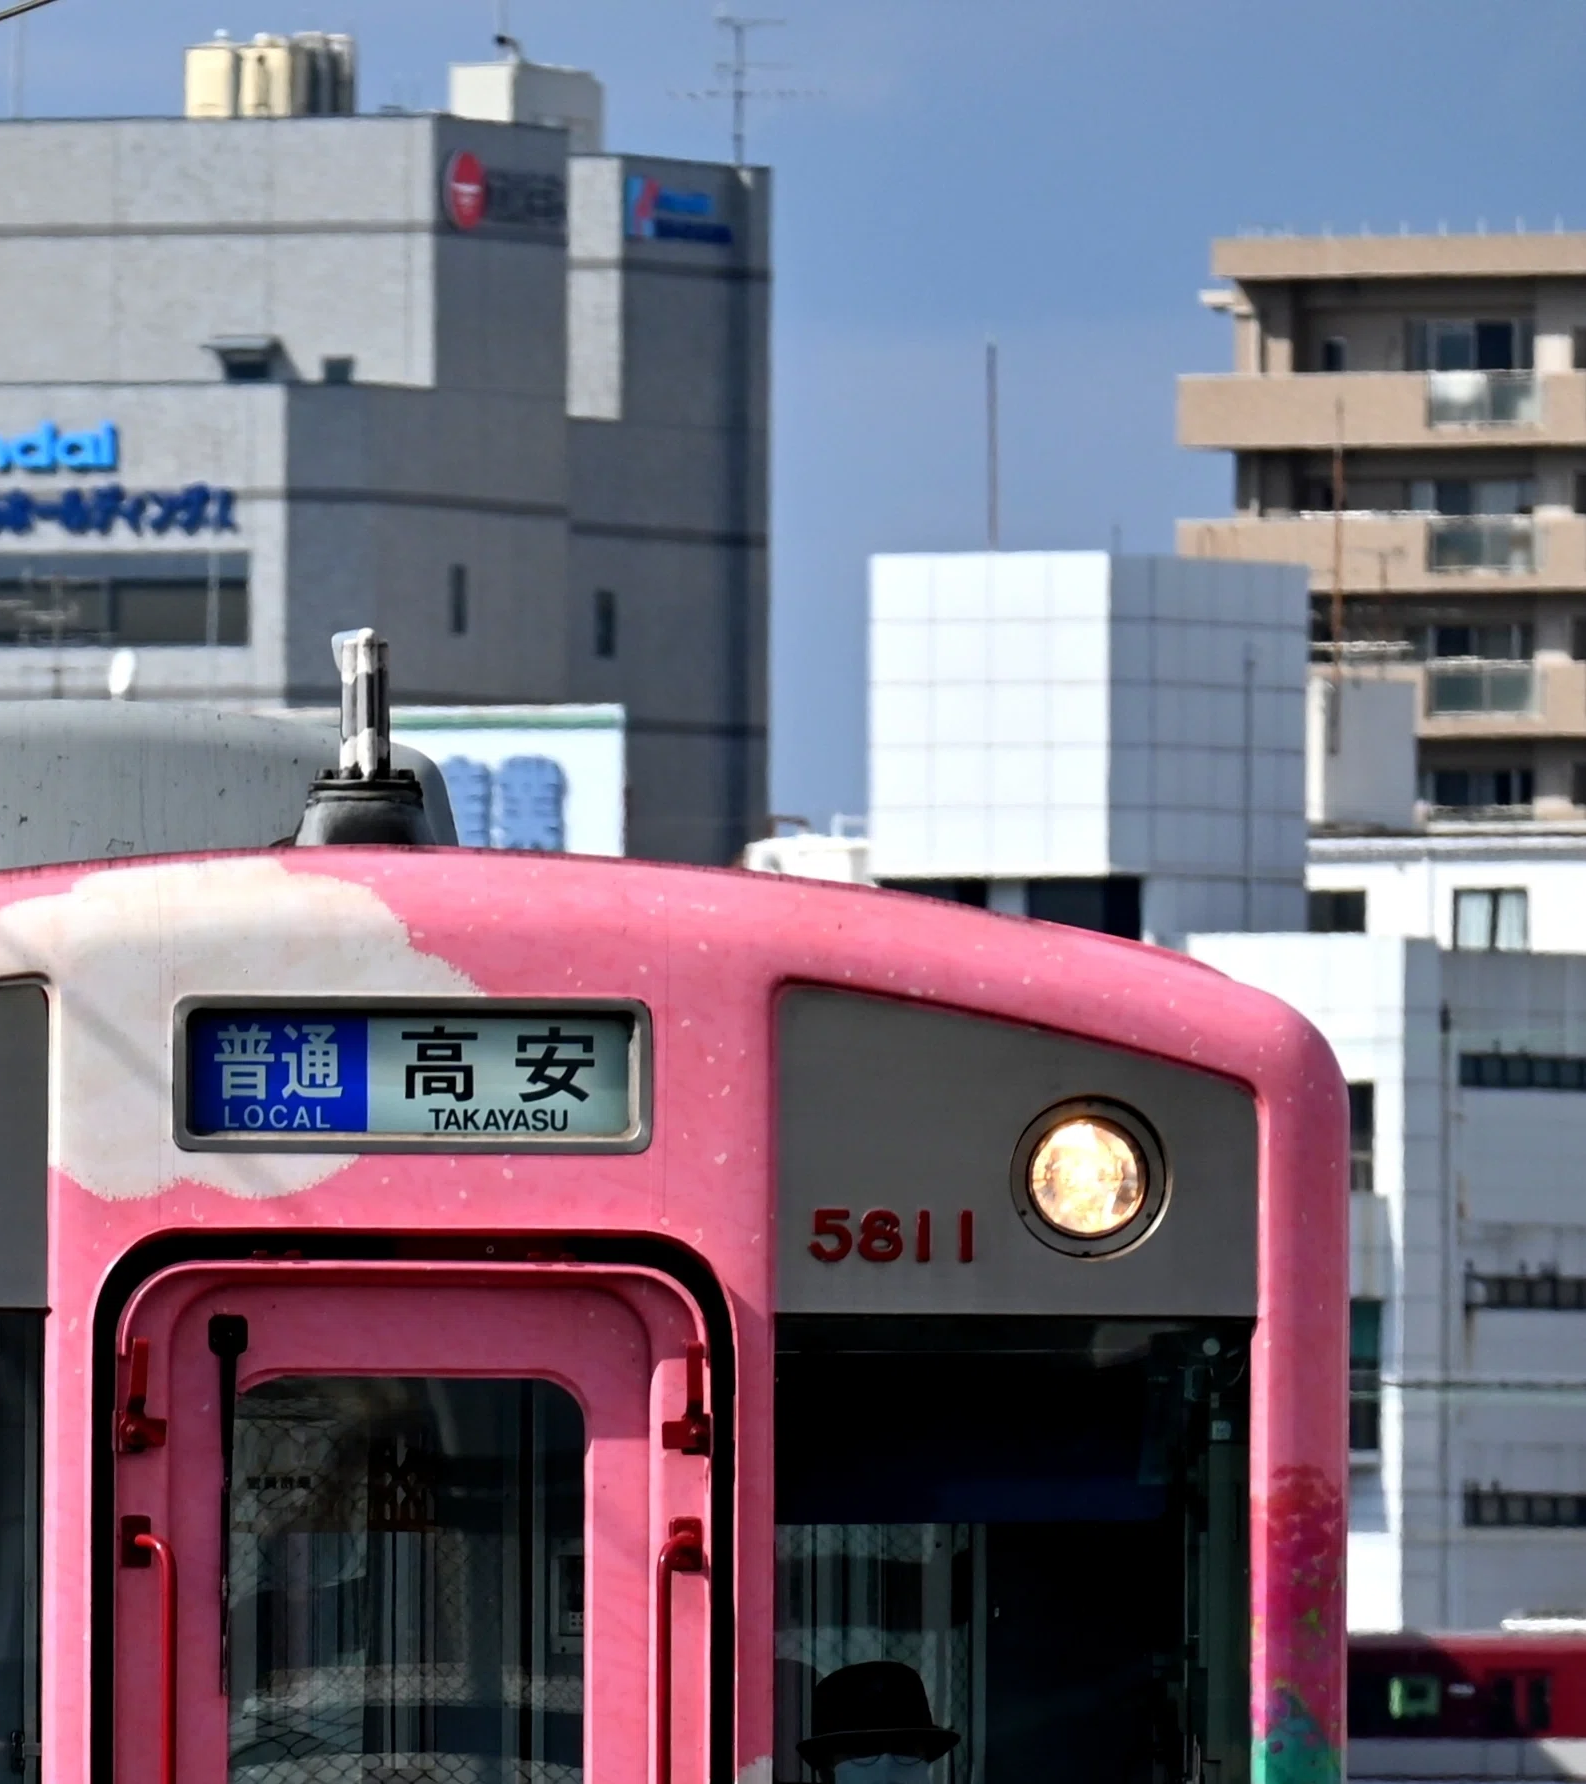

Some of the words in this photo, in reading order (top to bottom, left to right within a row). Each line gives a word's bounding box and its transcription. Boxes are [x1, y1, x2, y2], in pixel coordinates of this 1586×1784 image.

[213, 1023, 343, 1100] 普通
[401, 1025, 595, 1103] 高安
[224, 1105, 331, 1130] LOCAL
[428, 1107, 569, 1132] TAKAYASU
[808, 1208, 974, 1264] 5811
